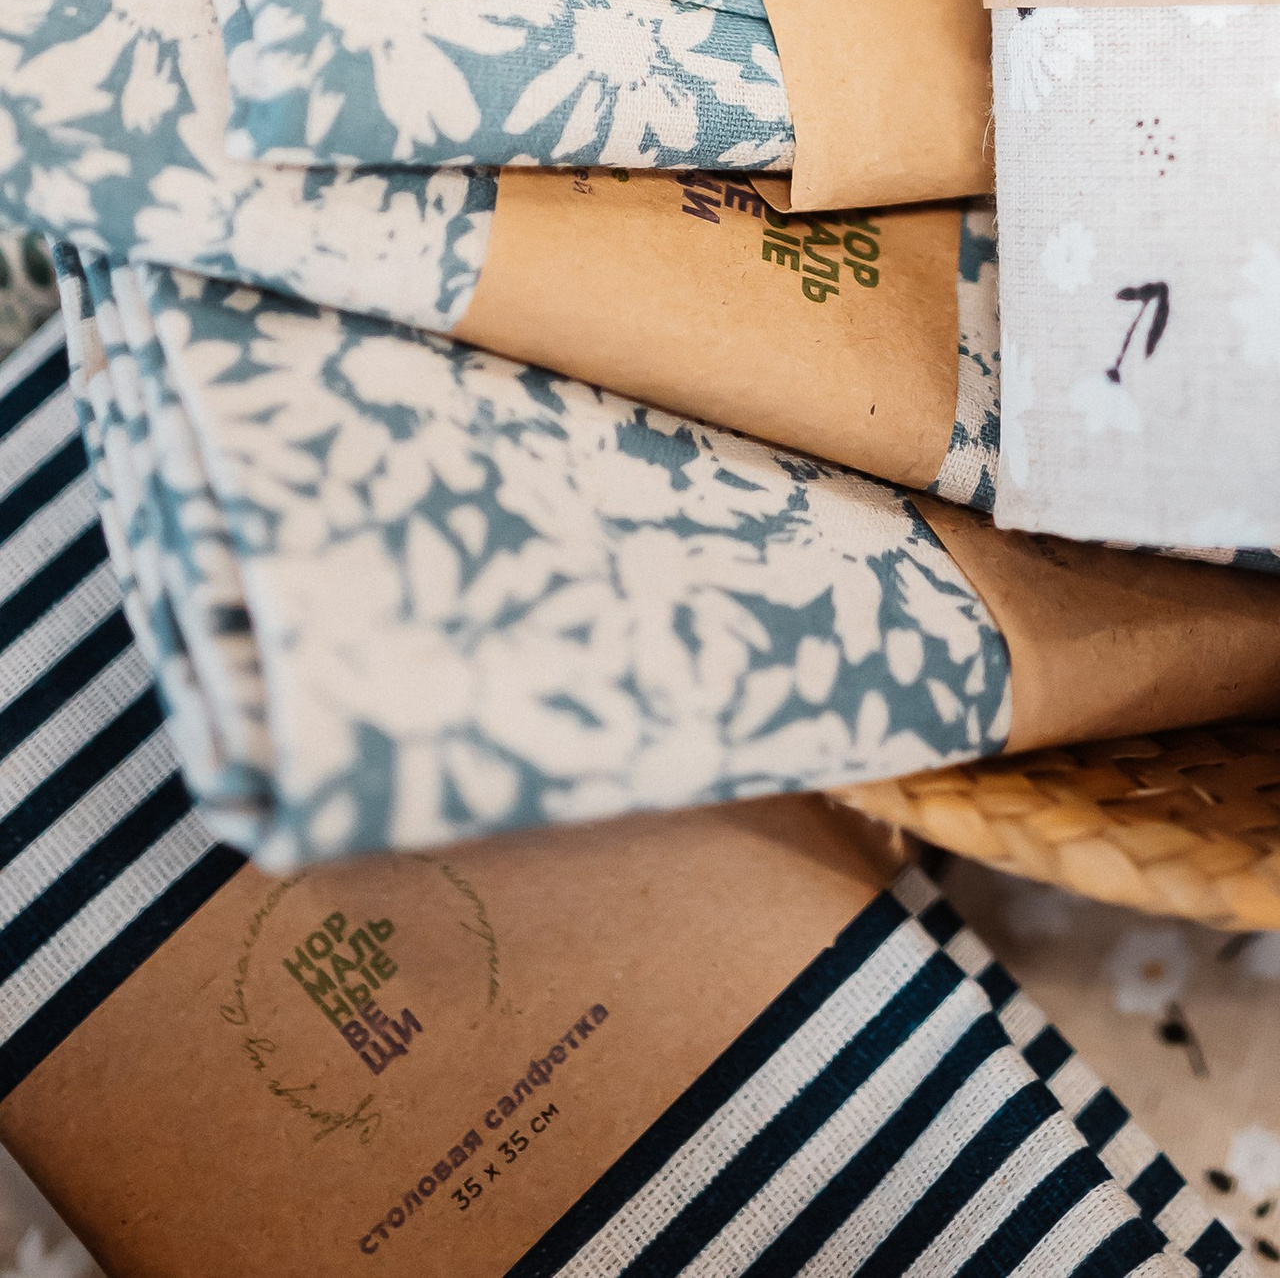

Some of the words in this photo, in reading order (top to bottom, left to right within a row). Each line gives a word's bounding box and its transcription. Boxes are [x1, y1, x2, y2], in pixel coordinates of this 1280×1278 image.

[282, 910, 348, 983] НОР
[303, 917, 396, 1006] МАЛЬ
[319, 949, 399, 1029] НЫЕ
[341, 999, 390, 1052] ВЕ
[359, 1007, 424, 1076] ЩИ
[359, 1128, 484, 1255] столовая
[484, 1003, 609, 1130] салфетка
[451, 1176, 484, 1211] 35
[498, 1129, 530, 1164] 35
[530, 1102, 560, 1134] см
